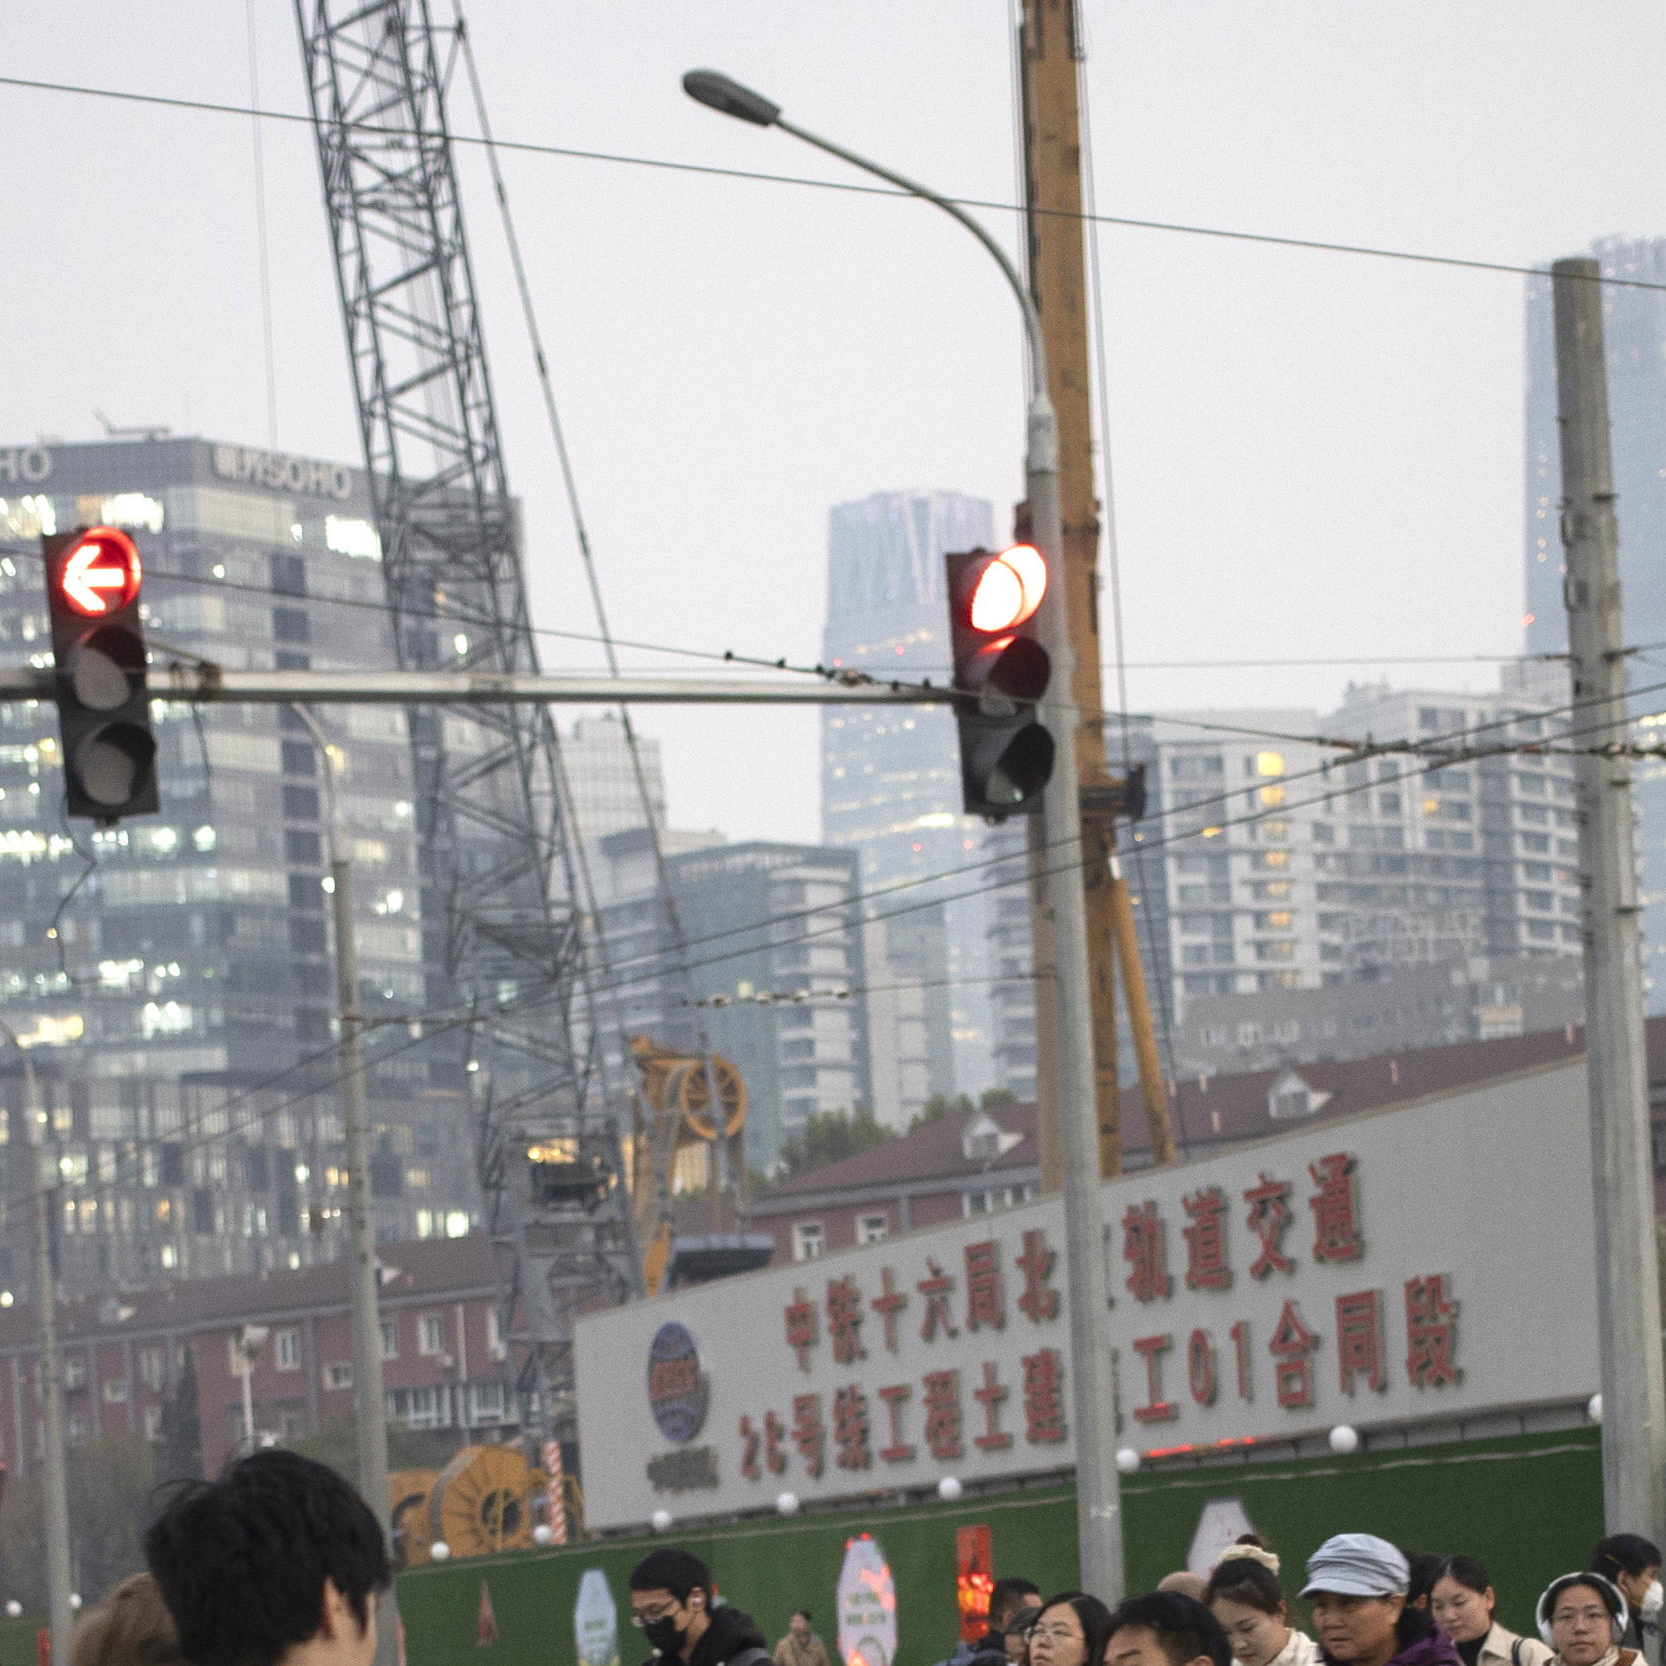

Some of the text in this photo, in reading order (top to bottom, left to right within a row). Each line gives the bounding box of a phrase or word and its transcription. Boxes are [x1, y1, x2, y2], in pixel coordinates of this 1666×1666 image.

[784, 1151, 1363, 1376] 中铁十六局北轨道交通
[738, 1272, 1461, 1481] 28号线工程土建工01合同段
